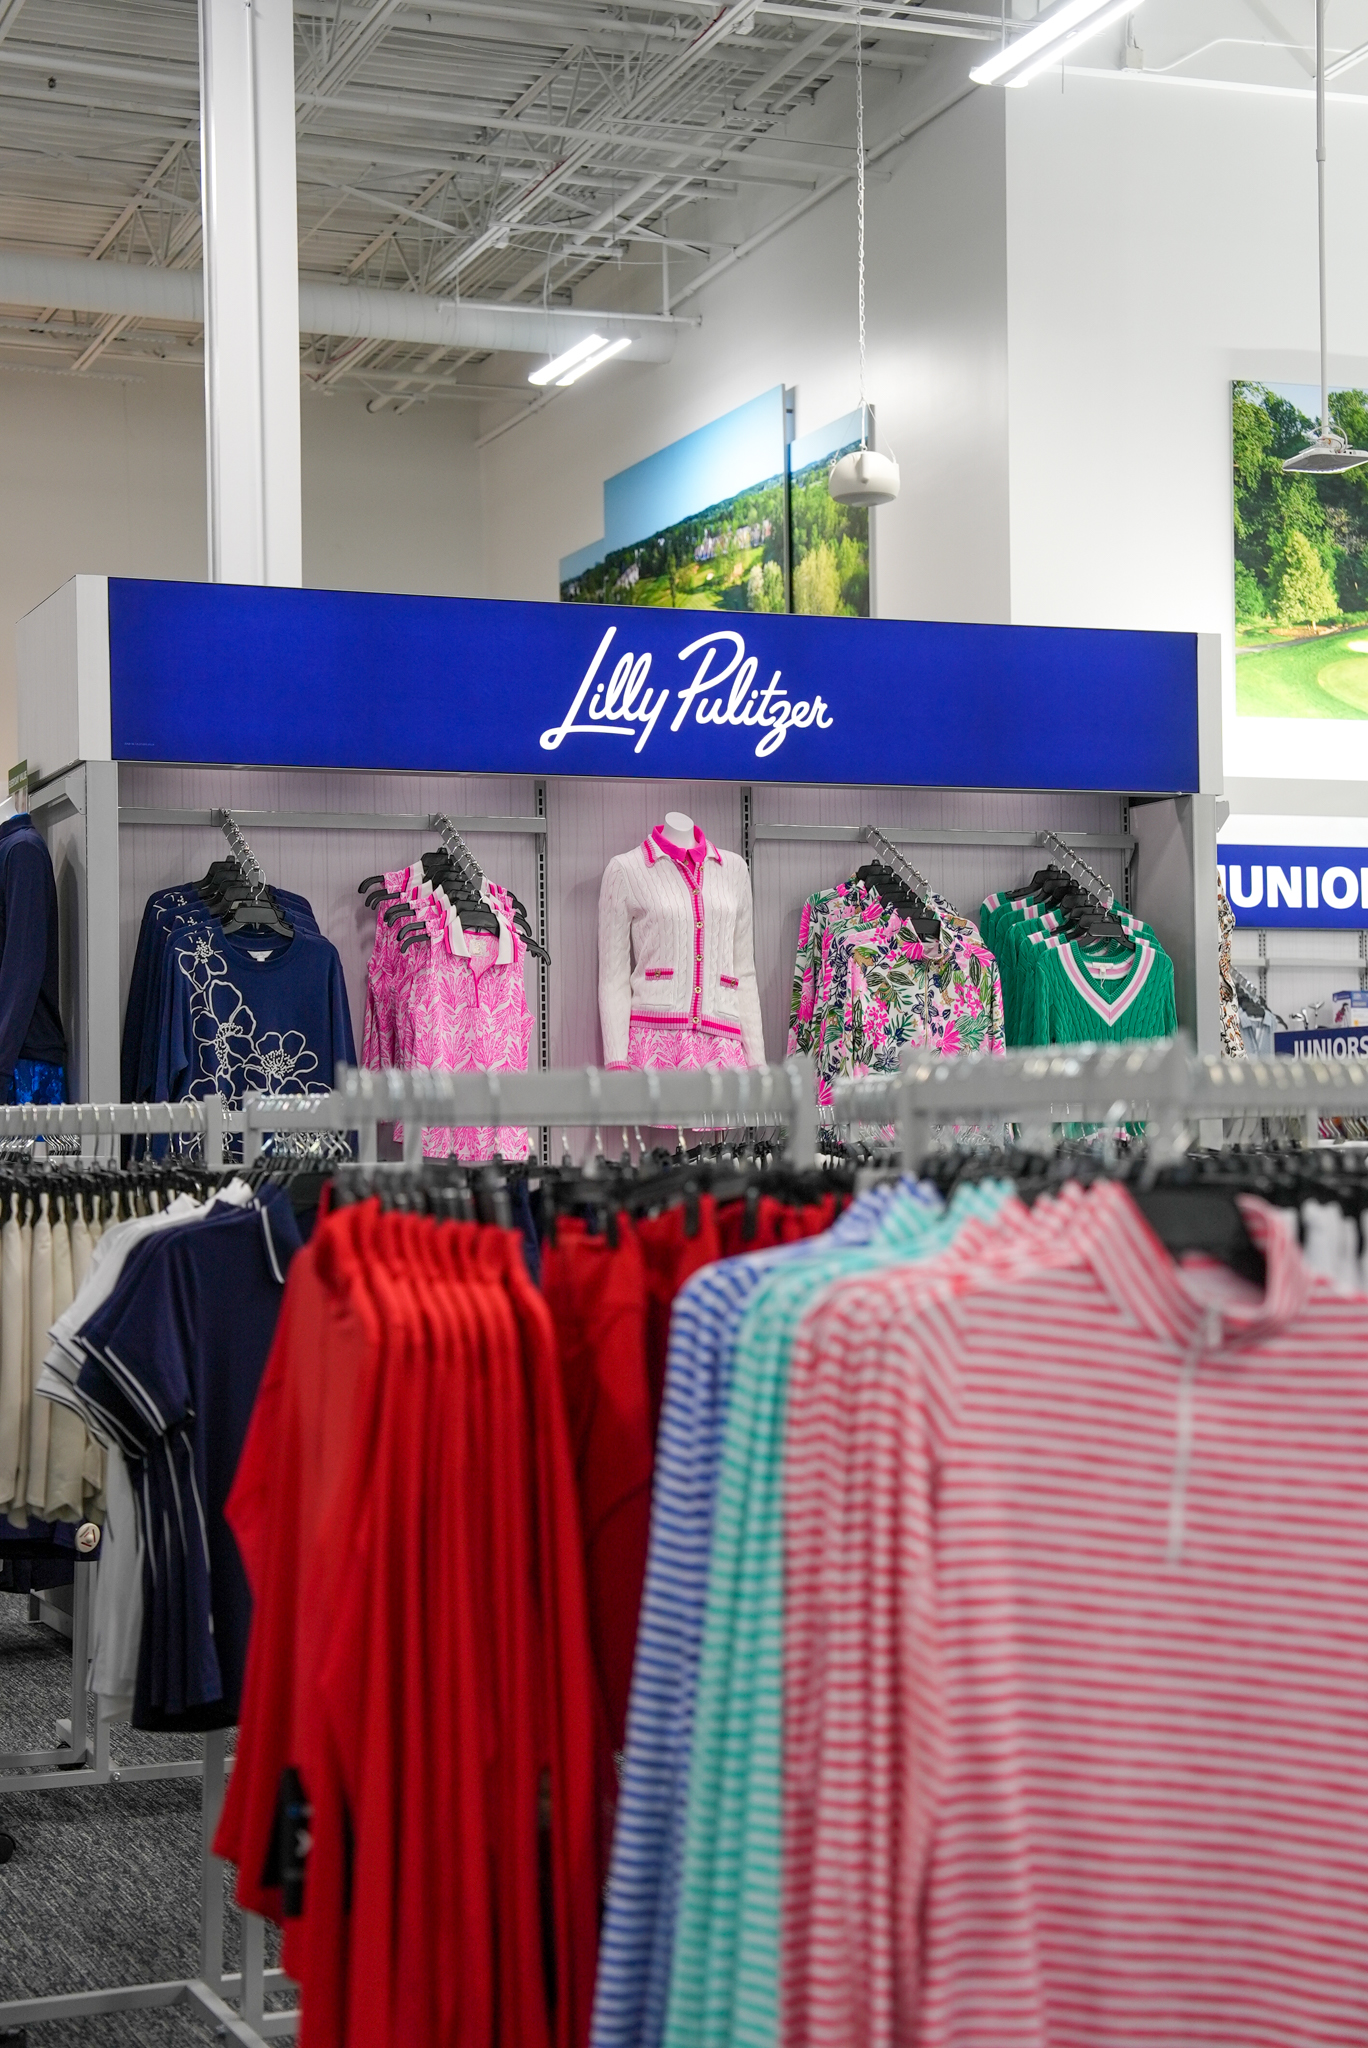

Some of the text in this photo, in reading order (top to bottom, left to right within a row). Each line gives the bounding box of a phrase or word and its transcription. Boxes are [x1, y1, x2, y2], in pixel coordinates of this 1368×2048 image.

[540, 627, 833, 757] Lilly Pulitzer
[1217, 865, 1368, 910] UNIO
